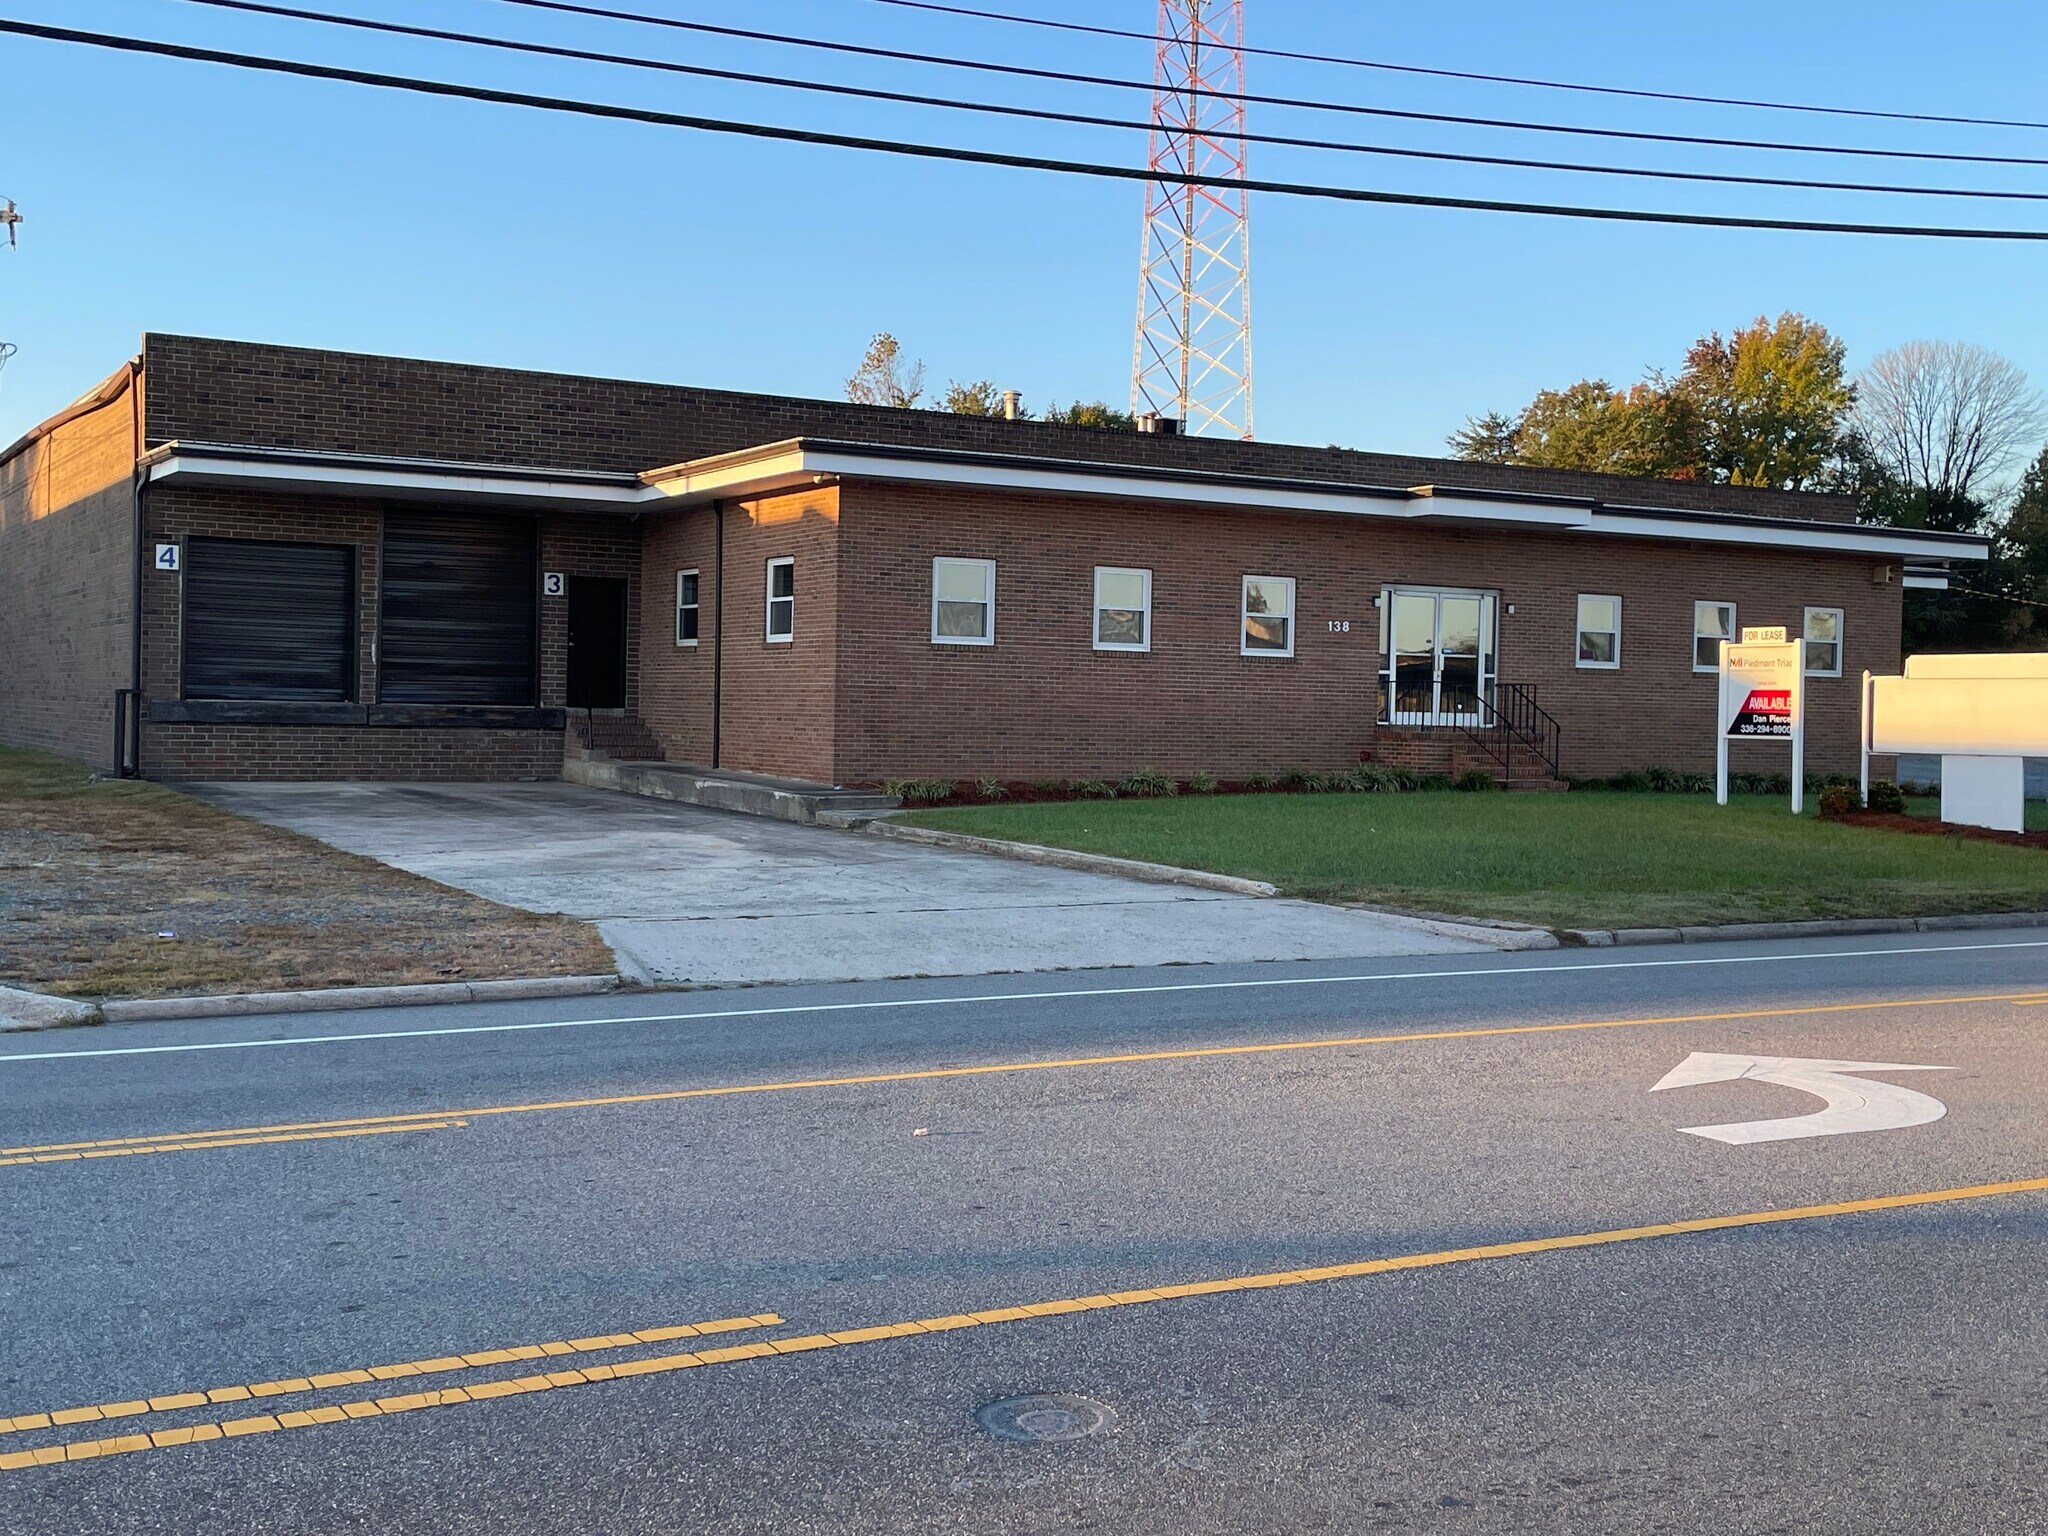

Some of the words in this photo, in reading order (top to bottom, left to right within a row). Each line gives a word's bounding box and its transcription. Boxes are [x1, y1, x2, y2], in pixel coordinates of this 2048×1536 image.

[159, 547, 175, 568] 4
[547, 574, 560, 594] 3
[1327, 620, 1350, 632] 138
[1744, 631, 1759, 641] FOR
[1760, 630, 1784, 640] LEASE
[1744, 658, 1775, 668] Piedmont
[1749, 696, 1791, 710] AVAILABLE
[1752, 714, 1767, 723] Dan
